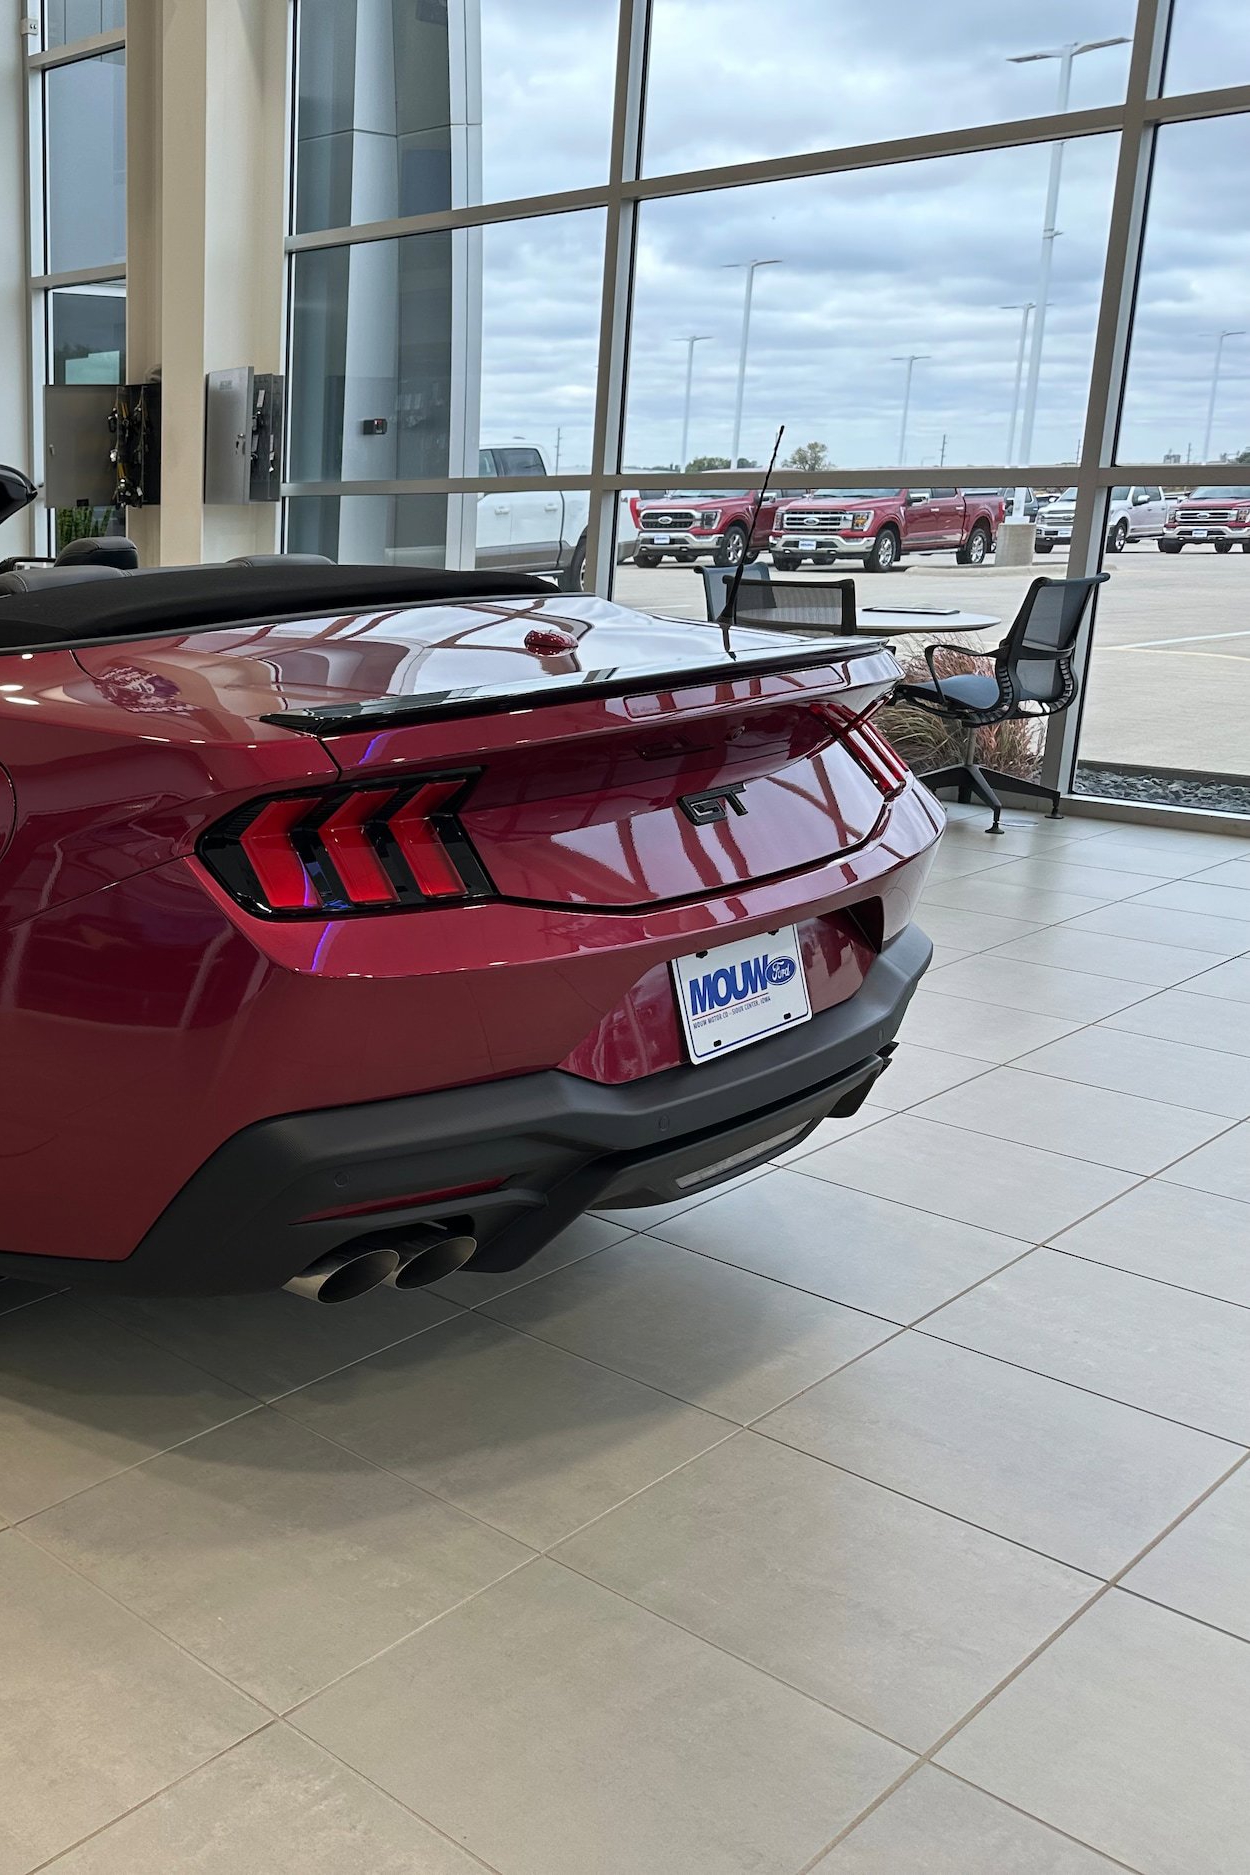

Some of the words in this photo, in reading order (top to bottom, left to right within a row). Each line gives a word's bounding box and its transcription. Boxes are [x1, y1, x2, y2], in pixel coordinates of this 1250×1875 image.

[677, 783, 748, 827] GT
[689, 954, 769, 1016] MOUW
[708, 1015, 722, 1025] MOTOR
[732, 1007, 744, 1016] SIOUX
